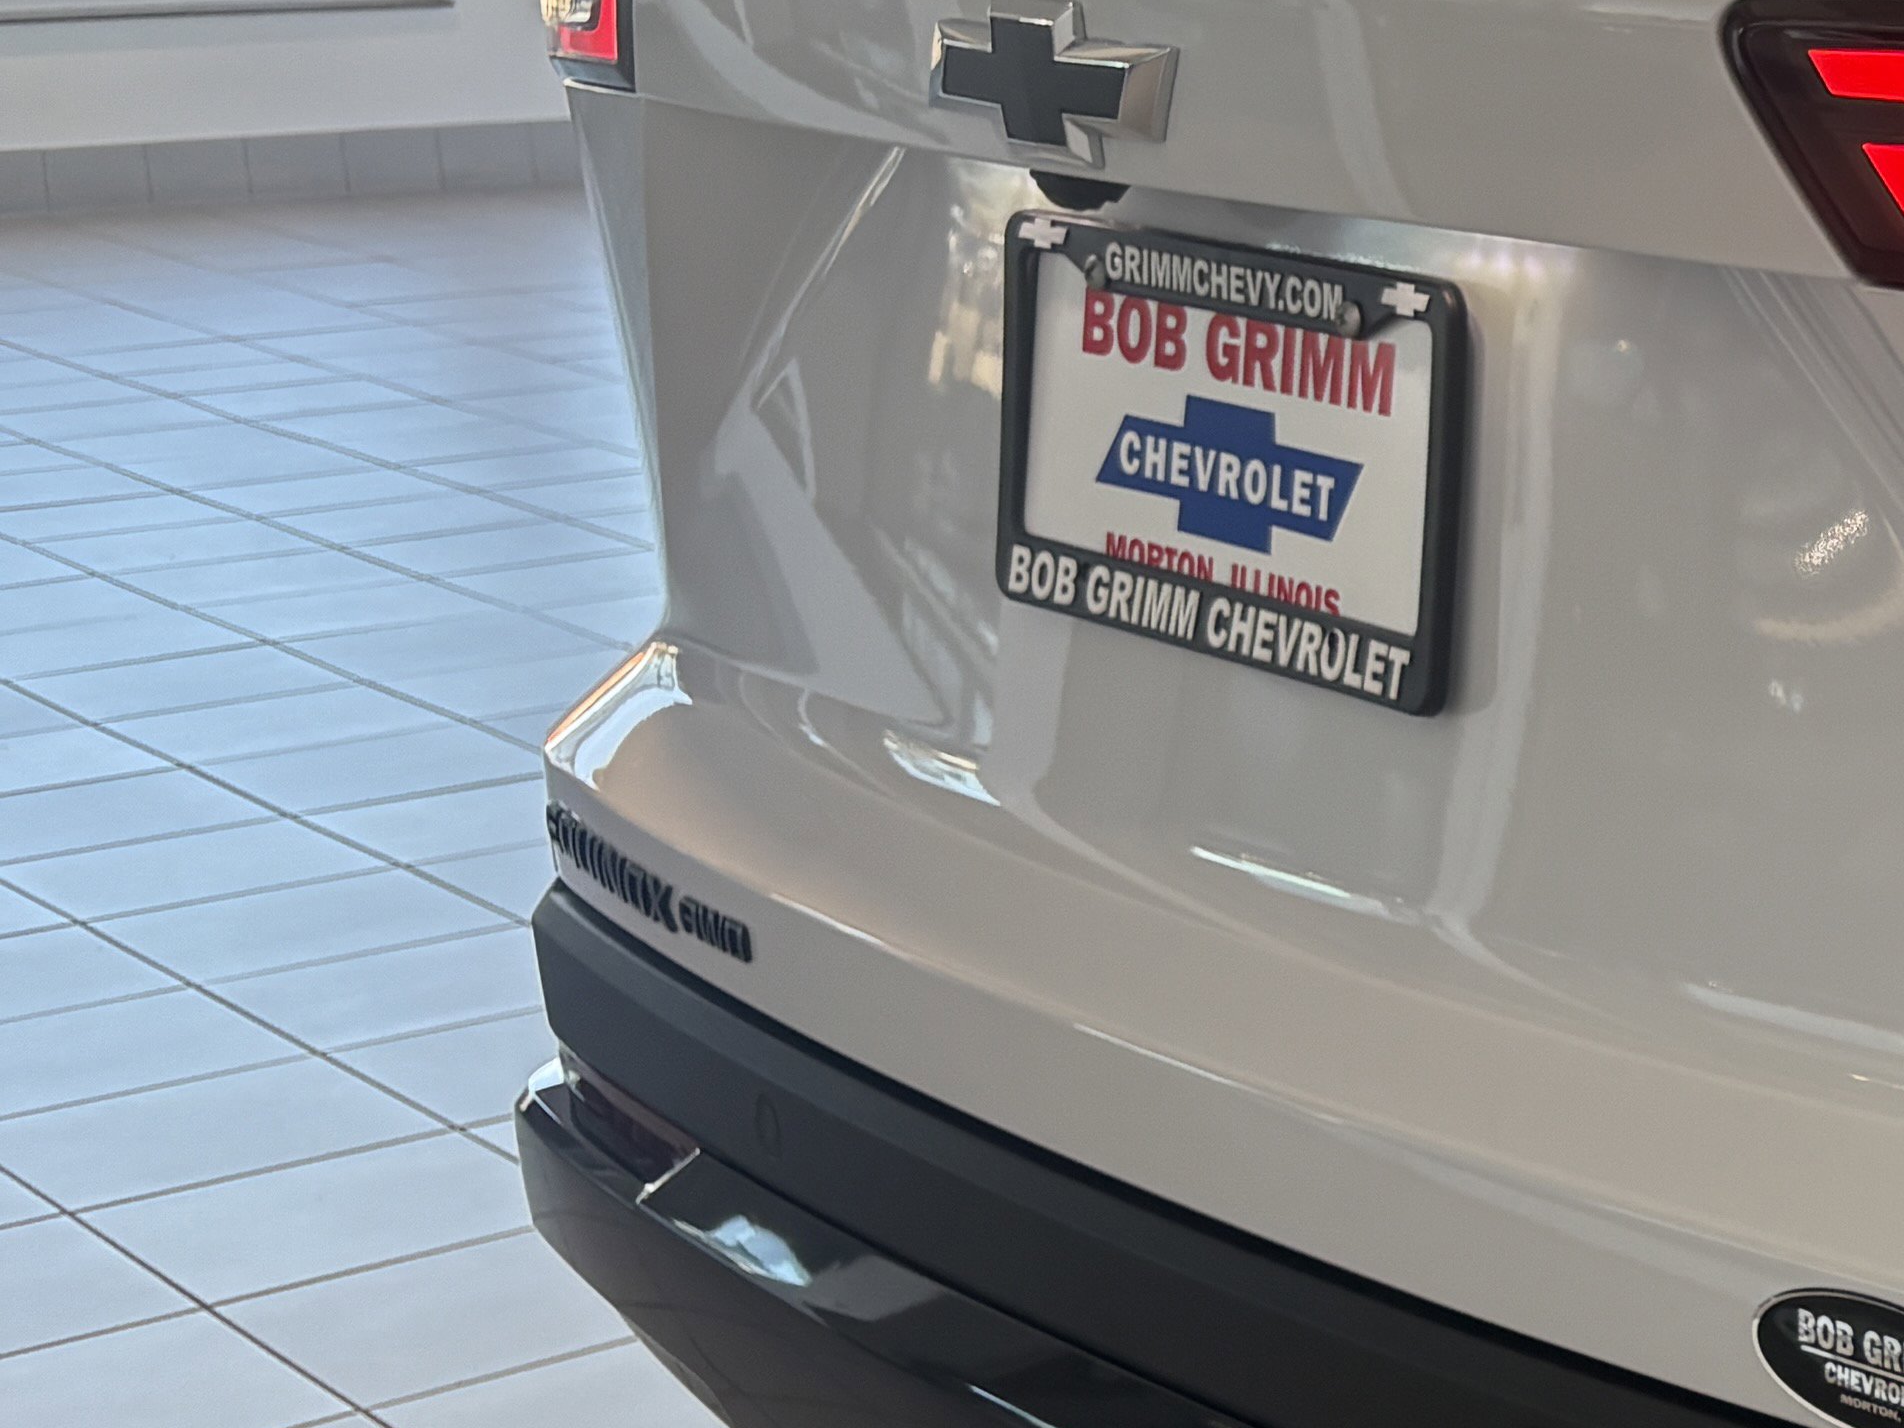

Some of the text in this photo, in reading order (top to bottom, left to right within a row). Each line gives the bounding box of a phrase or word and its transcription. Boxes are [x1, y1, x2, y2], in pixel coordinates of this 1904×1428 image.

[1104, 241, 1343, 322] GRIMMCHEVY.COM
[1081, 288, 1397, 418] BOB GRIMM
[1118, 430, 1336, 522] CHEVROLET
[1007, 544, 1411, 701] BOB GRIMM CHEVROLET
[1797, 1307, 1855, 1357] BOB
